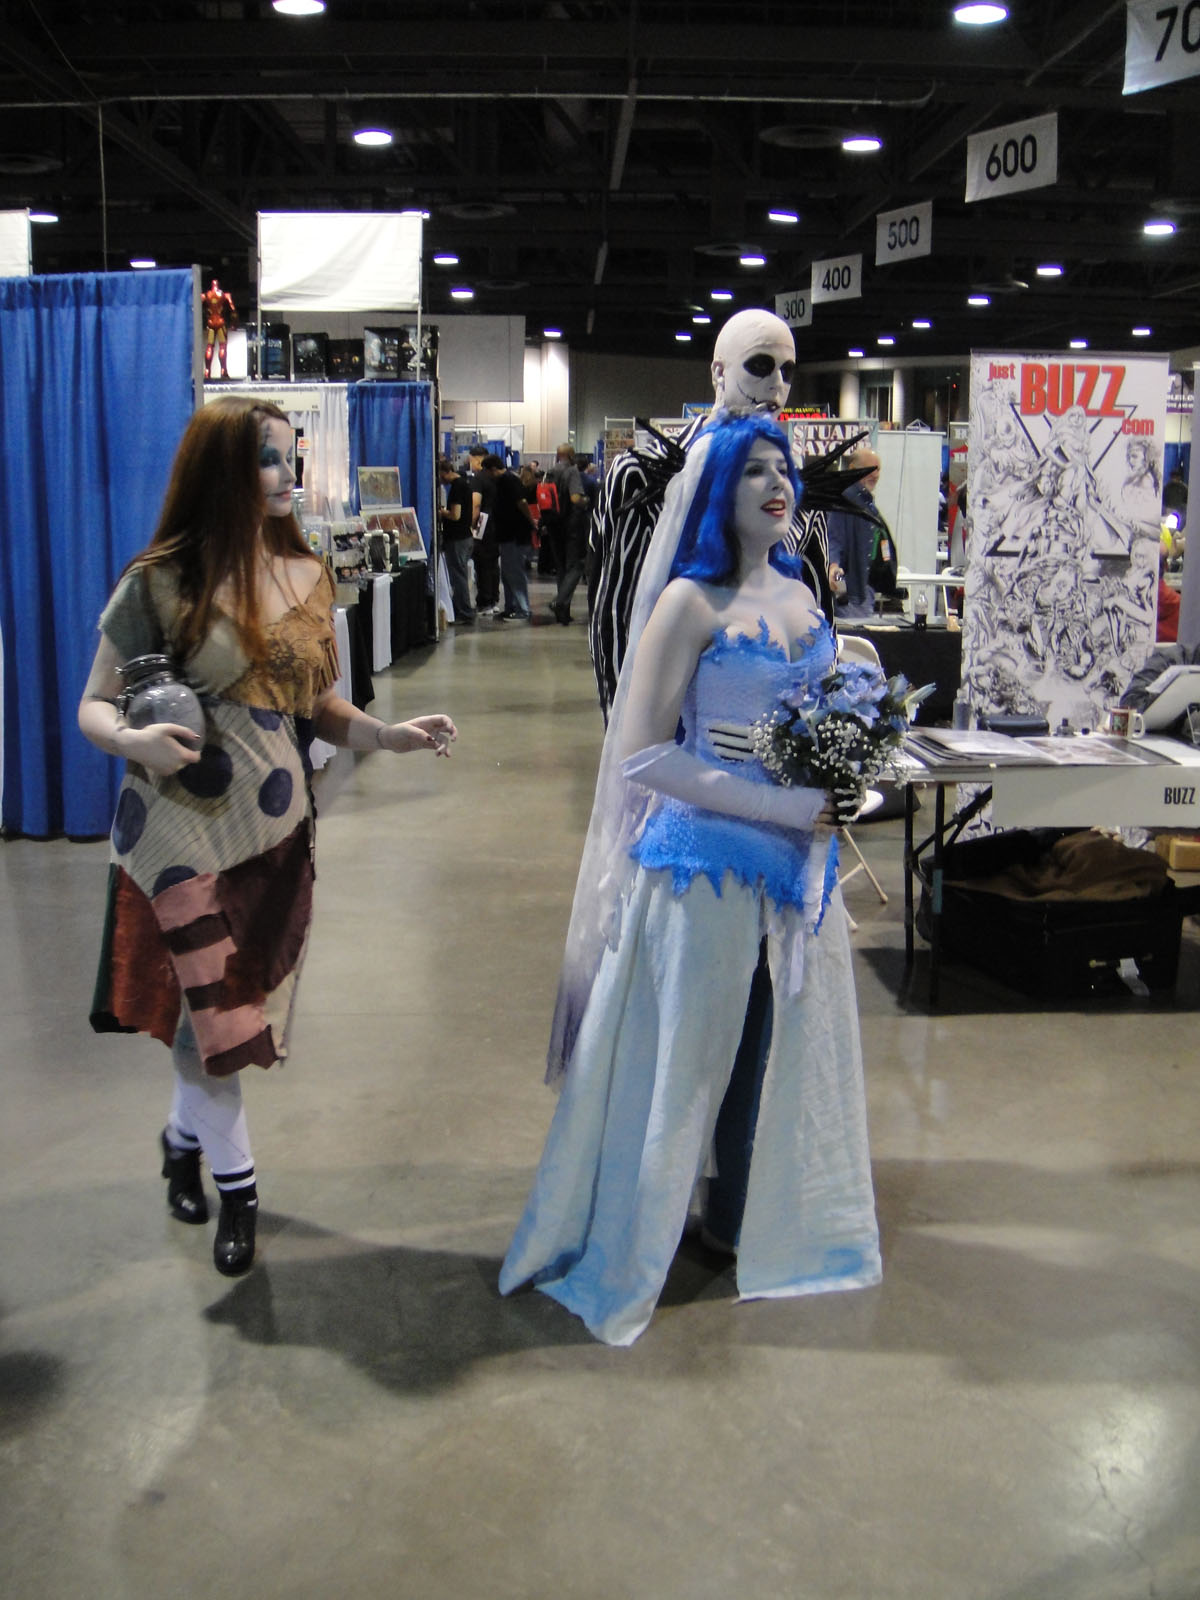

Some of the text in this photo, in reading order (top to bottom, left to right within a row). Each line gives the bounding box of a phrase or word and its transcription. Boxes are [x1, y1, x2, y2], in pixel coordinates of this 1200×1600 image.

[985, 133, 1037, 182] 600
[887, 215, 920, 250] 500
[821, 265, 851, 291] 400
[783, 297, 805, 320] 300
[988, 362, 1126, 417] just BUZZ
[793, 424, 874, 441] STUART
[1164, 786, 1196, 805] BUZZ
